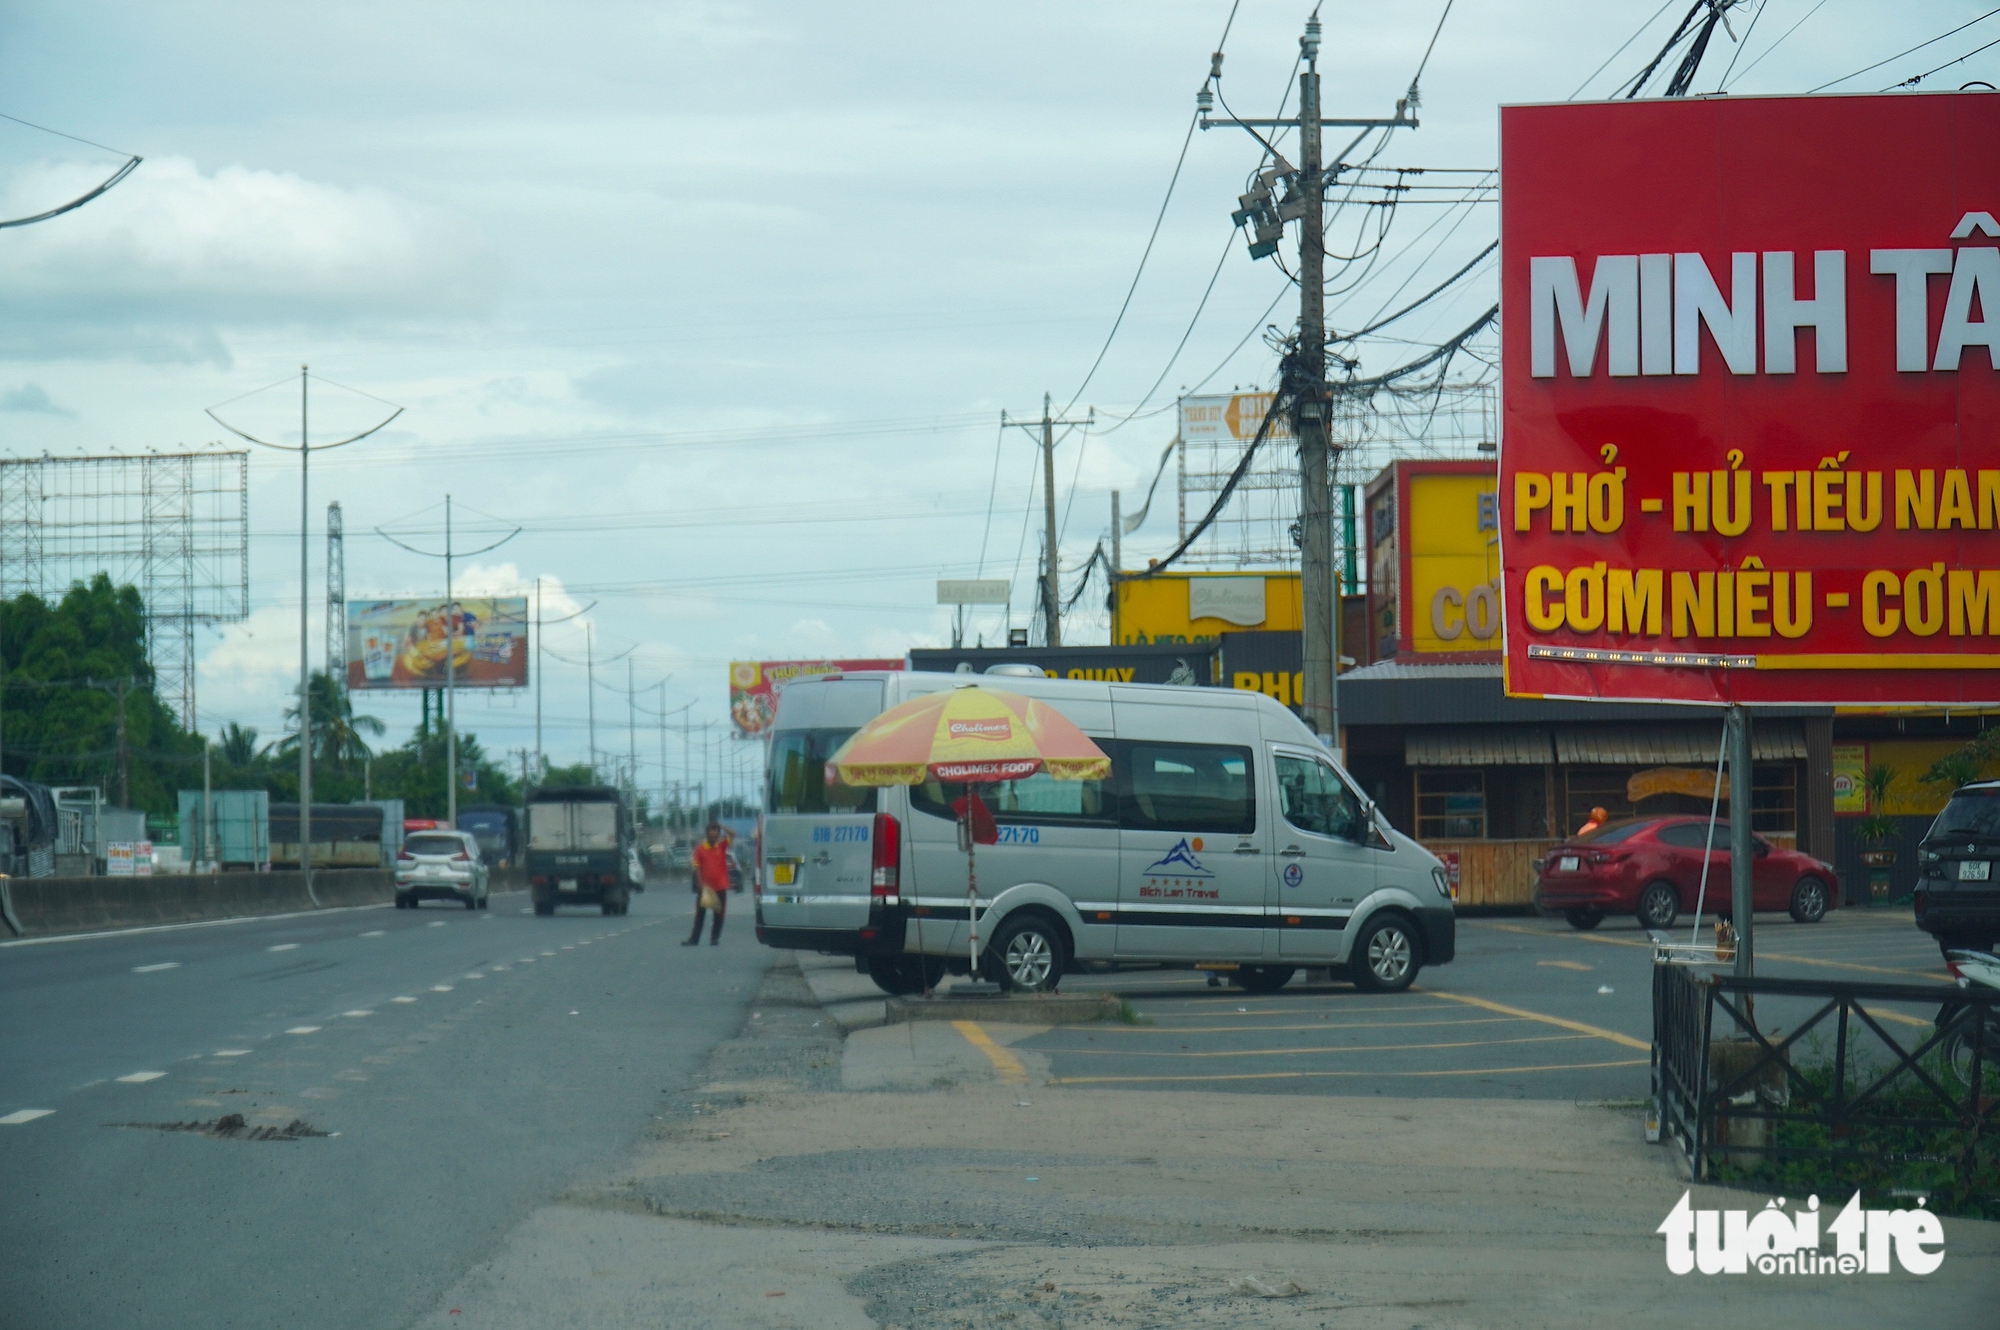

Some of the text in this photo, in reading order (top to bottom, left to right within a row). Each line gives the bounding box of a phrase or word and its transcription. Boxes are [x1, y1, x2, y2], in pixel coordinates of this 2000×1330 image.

[1529, 250, 1848, 378] MINH
[1515, 443, 1627, 533] PHỞ
[1673, 449, 1752, 537] HỦ
[1763, 450, 1883, 533] TIẾU
[1525, 561, 1664, 637] CƠM
[1671, 555, 1813, 639] NIÊU
[1862, 562, 2000, 638] CƠM
[950, 719, 1009, 734] Cholimex
[936, 763, 999, 777] CHOLIMEX
[1002, 761, 1035, 773] FOOD
[1140, 886, 1219, 899] Bích Lan Travel
